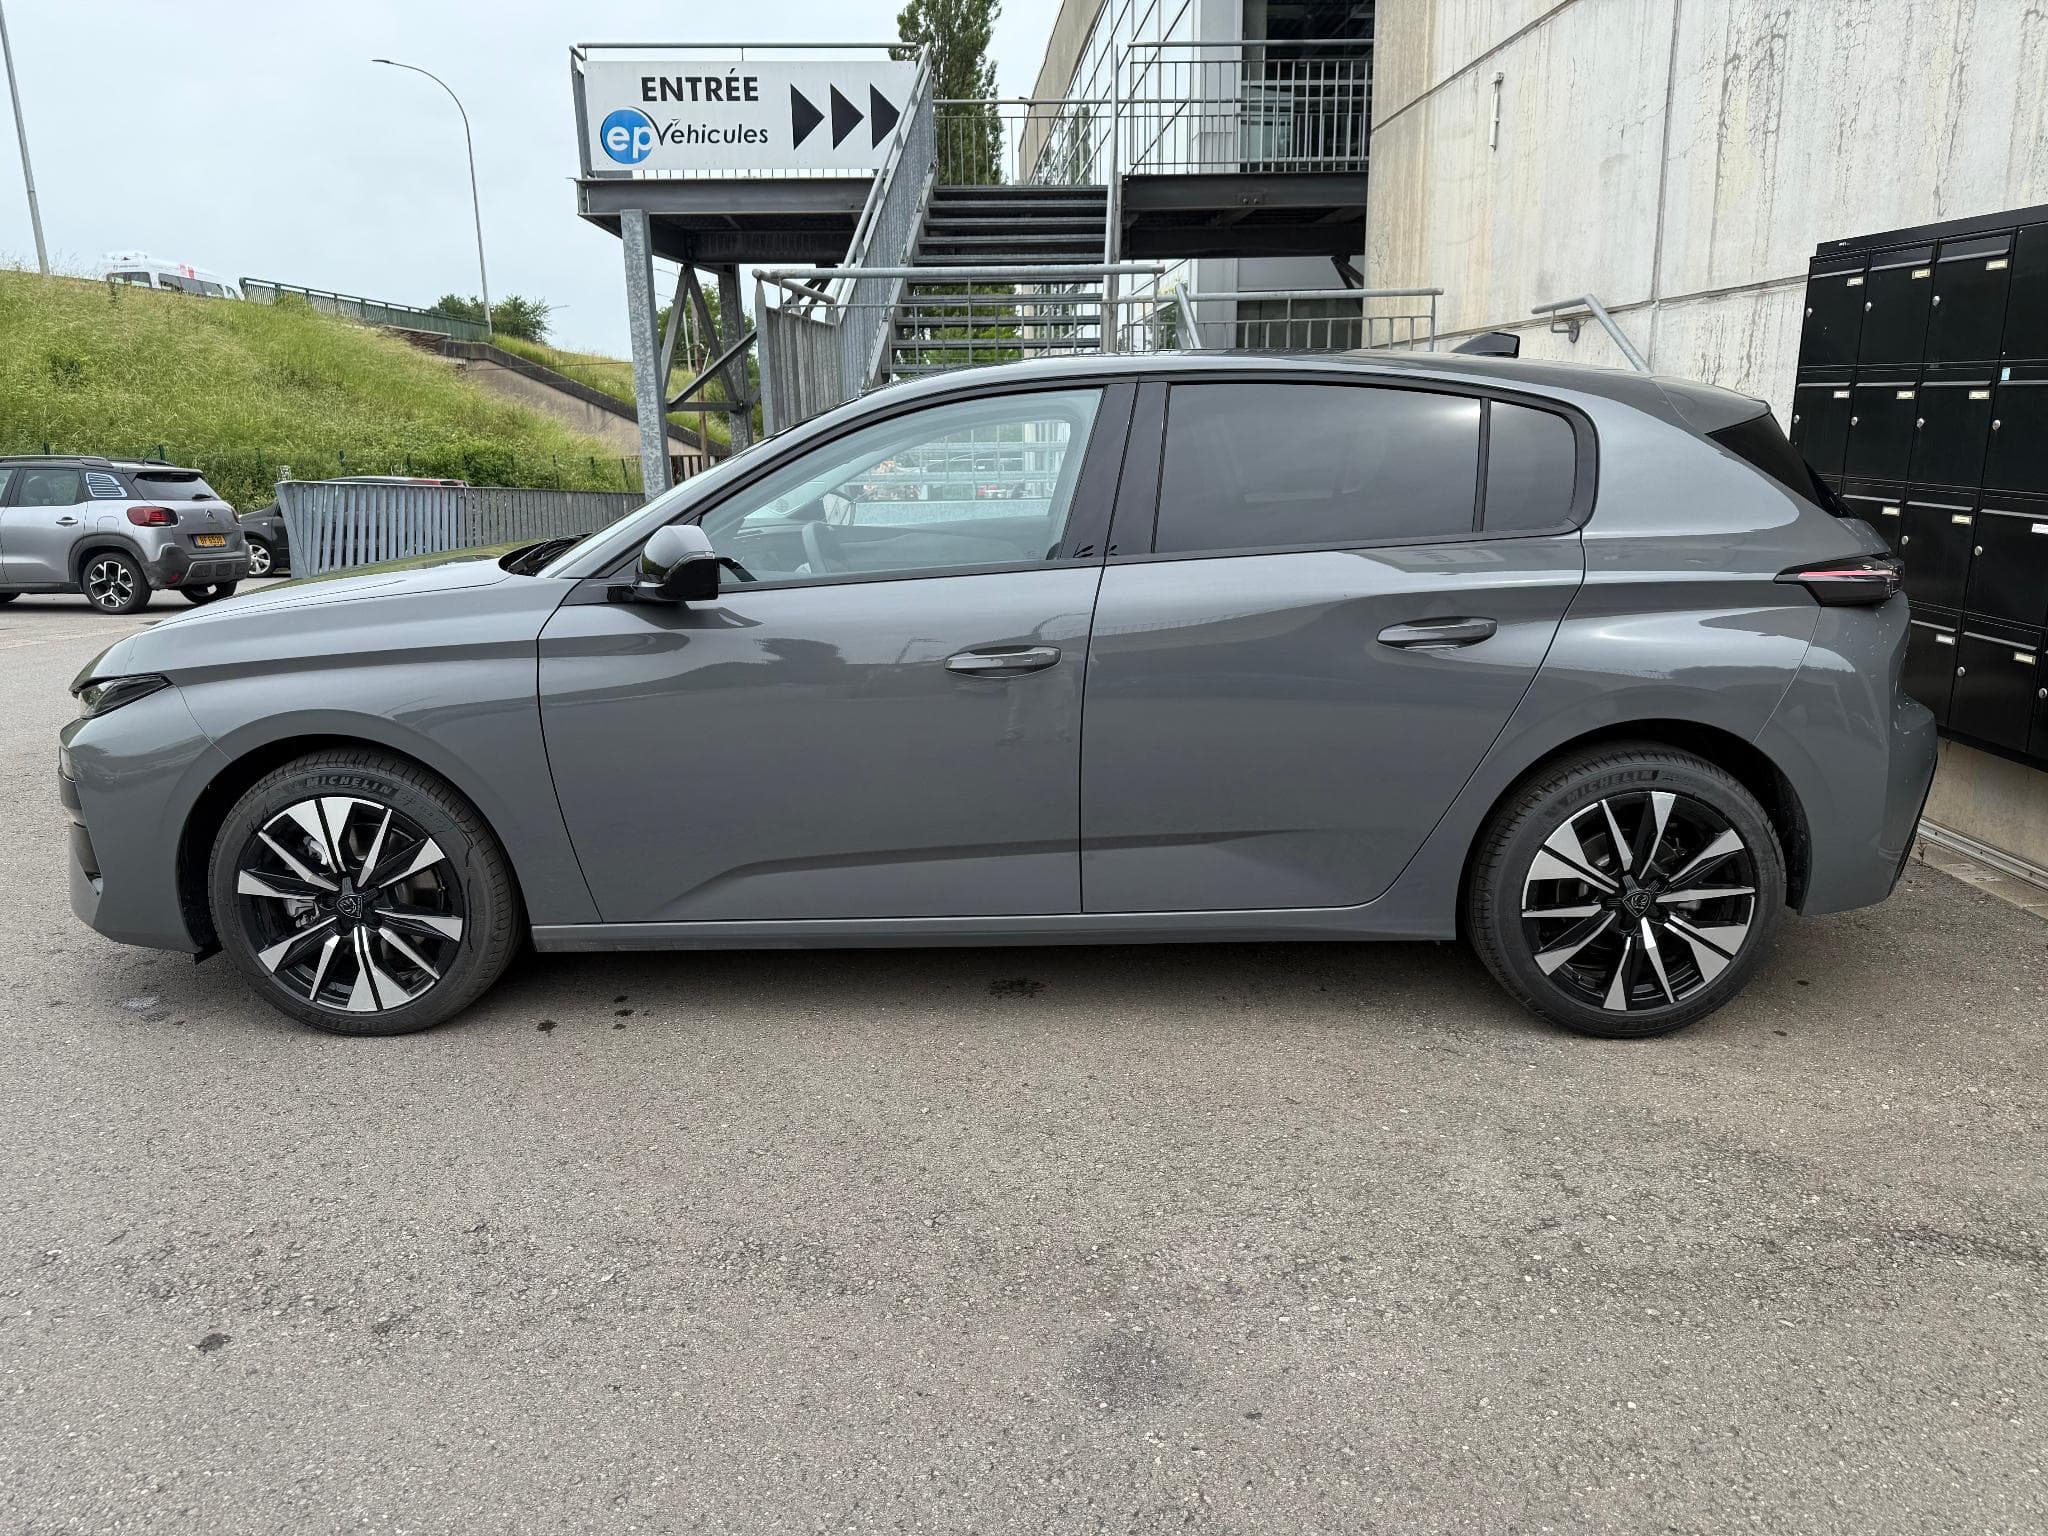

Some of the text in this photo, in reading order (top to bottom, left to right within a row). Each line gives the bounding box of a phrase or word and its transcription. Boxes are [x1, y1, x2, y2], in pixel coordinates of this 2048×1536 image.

[641, 68, 759, 102] ENTRÉE
[606, 126, 654, 159] ep
[305, 775, 394, 796] MICHELIN
